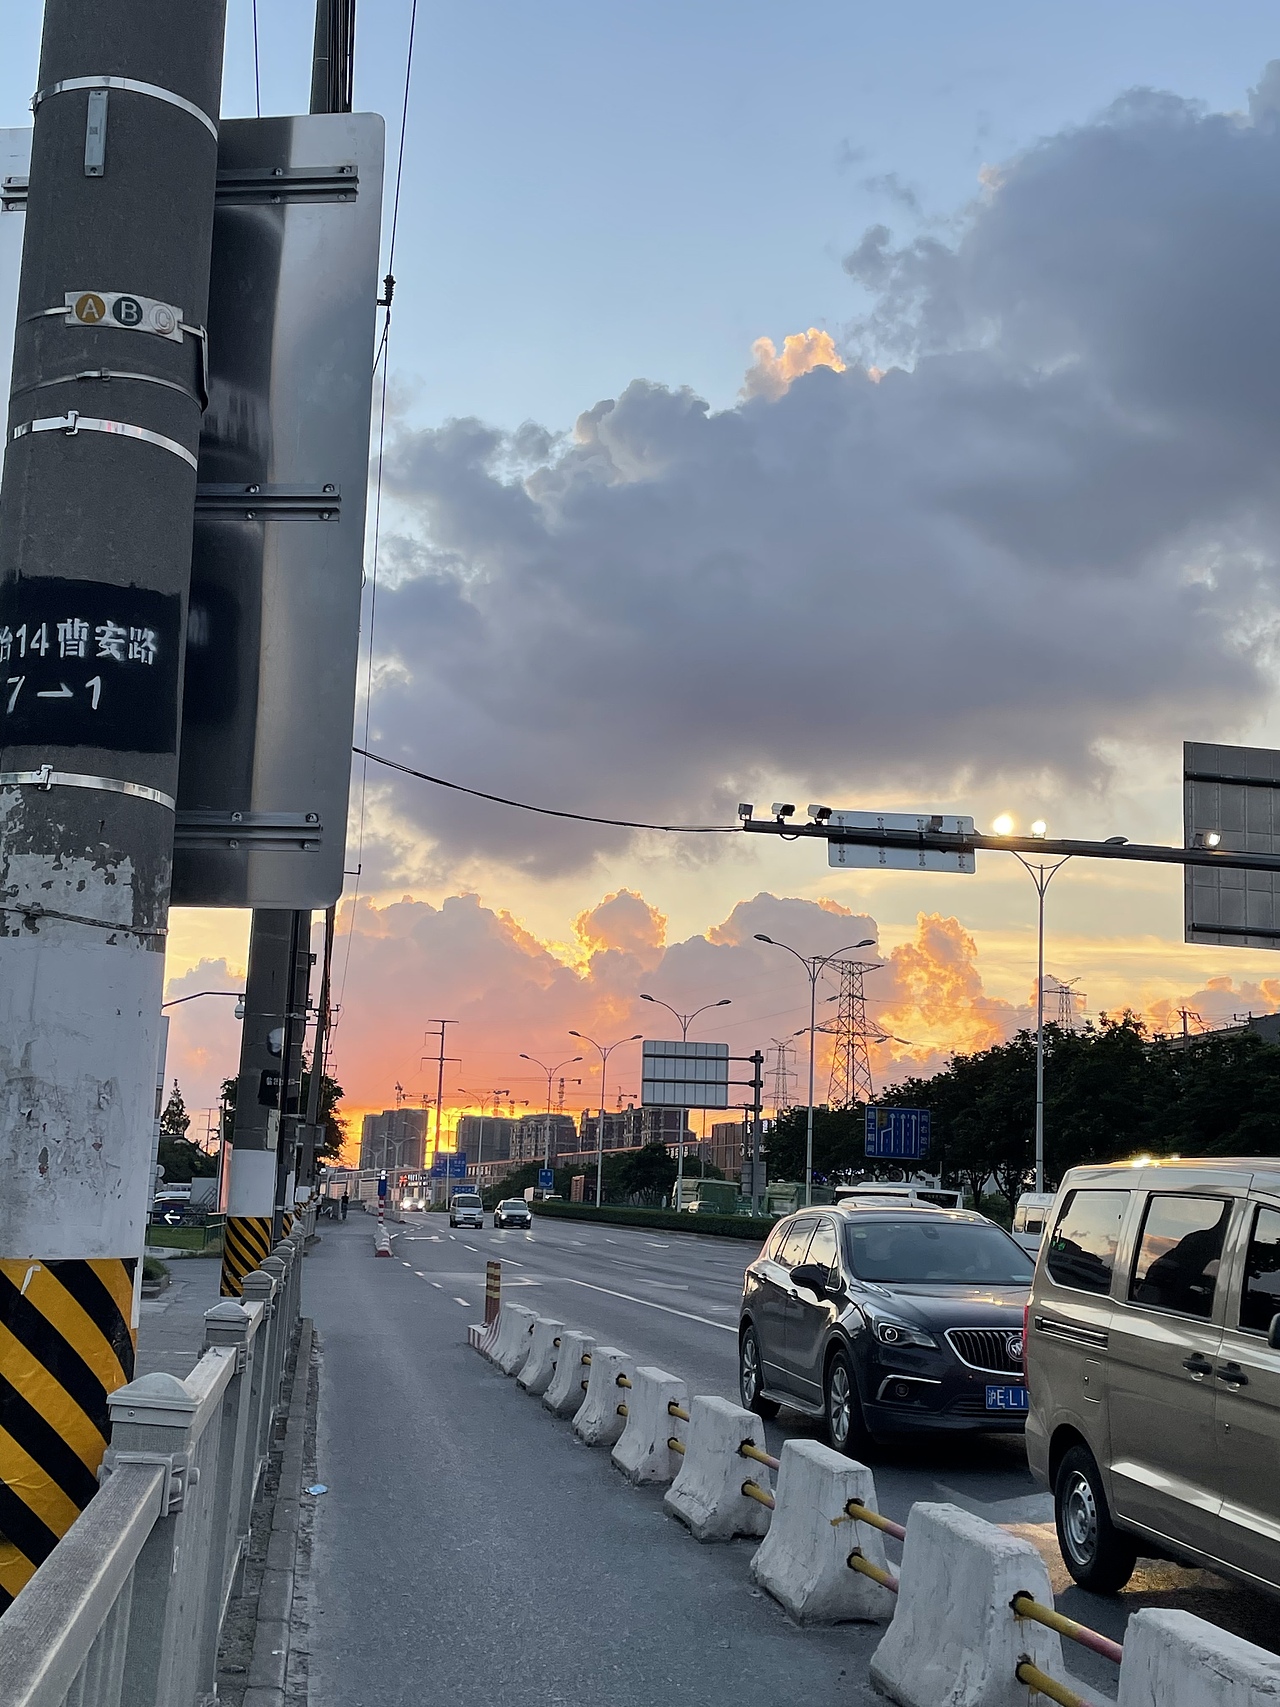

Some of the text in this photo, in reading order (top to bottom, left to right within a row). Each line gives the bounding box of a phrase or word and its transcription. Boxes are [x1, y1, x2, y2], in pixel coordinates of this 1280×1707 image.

[82, 298, 171, 330] A B C
[7, 675, 102, 714] 7 1
